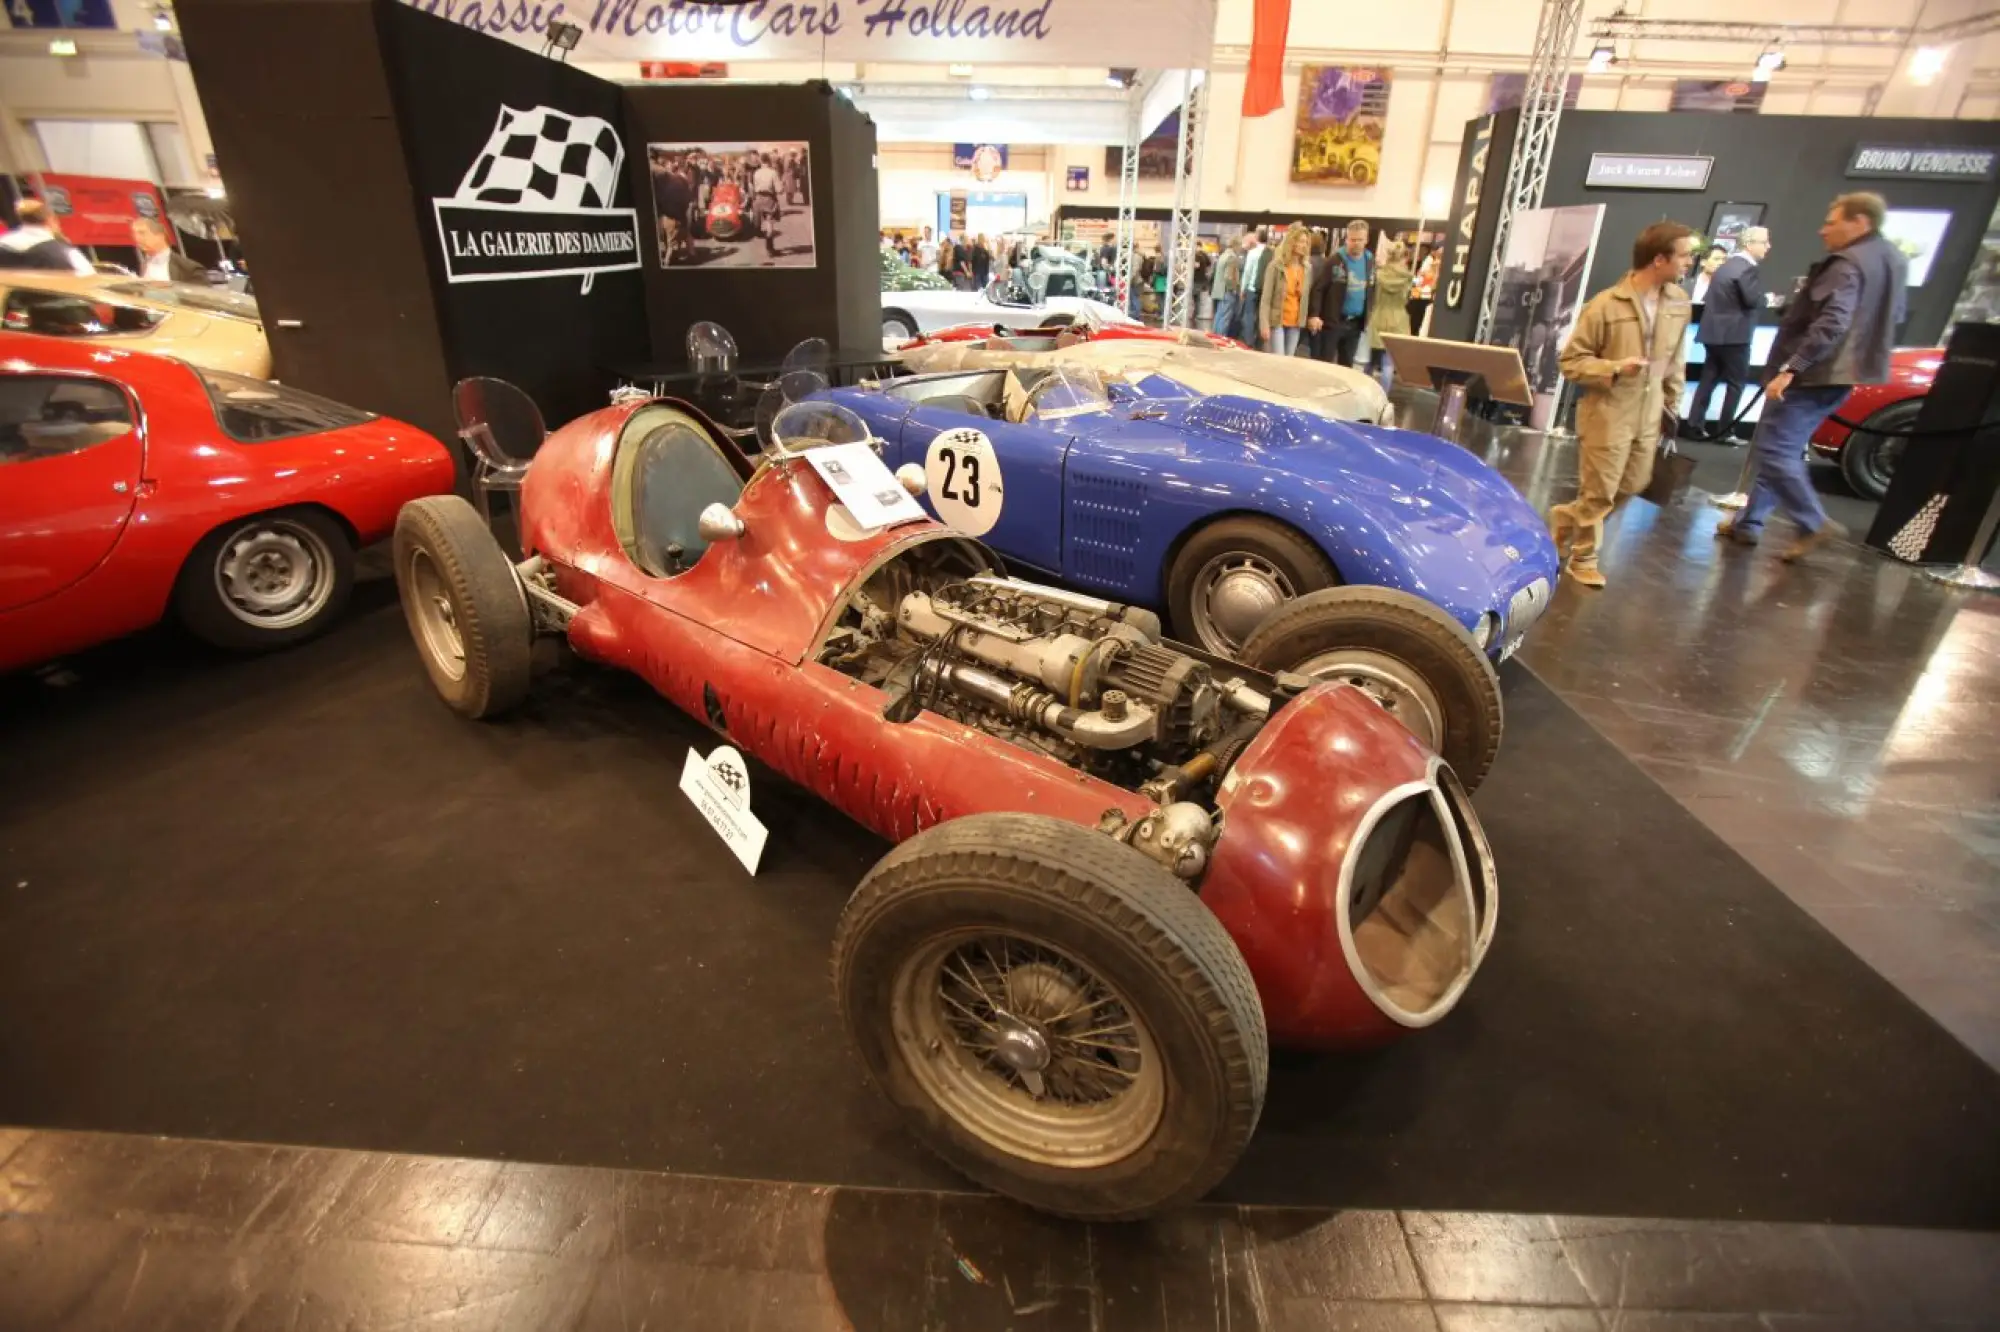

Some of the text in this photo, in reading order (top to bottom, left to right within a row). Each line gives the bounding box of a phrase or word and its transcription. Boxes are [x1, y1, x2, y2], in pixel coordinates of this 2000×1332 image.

[409, 0, 565, 33] lassic
[864, 0, 1055, 40] Holland
[1855, 149, 1912, 171] BRUNO
[1446, 113, 1496, 308] CHAPAL
[450, 230, 634, 257] LA GALERIE DES DAMIERS
[939, 448, 980, 508] 23
